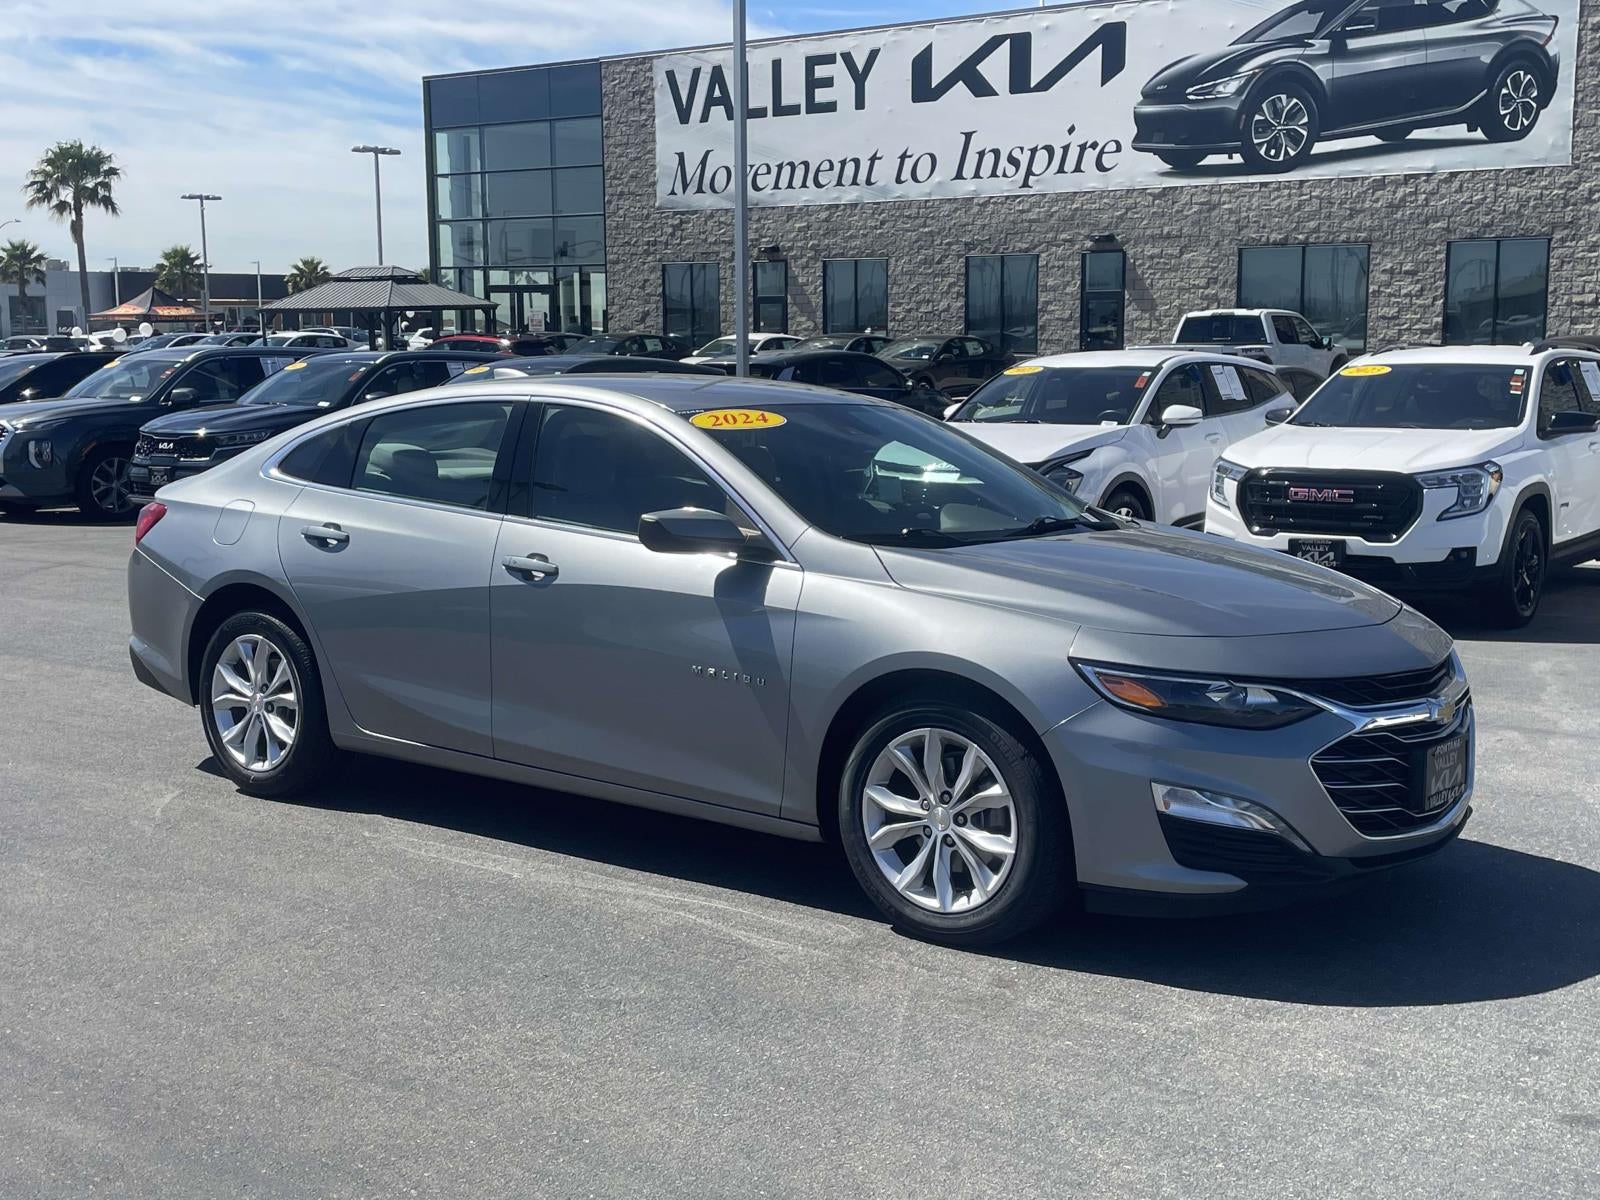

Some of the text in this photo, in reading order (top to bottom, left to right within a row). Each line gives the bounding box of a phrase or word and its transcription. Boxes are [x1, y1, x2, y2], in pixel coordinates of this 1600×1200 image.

[665, 21, 1127, 125] VALLEY KIA
[895, 146, 938, 185] to
[951, 124, 1123, 189] Inspire
[707, 412, 769, 427] 2024
[1288, 487, 1354, 503] GMC
[691, 665, 765, 687] MALIBU
[1435, 751, 1458, 771] VALLEY
[1431, 762, 1463, 796] KIA
